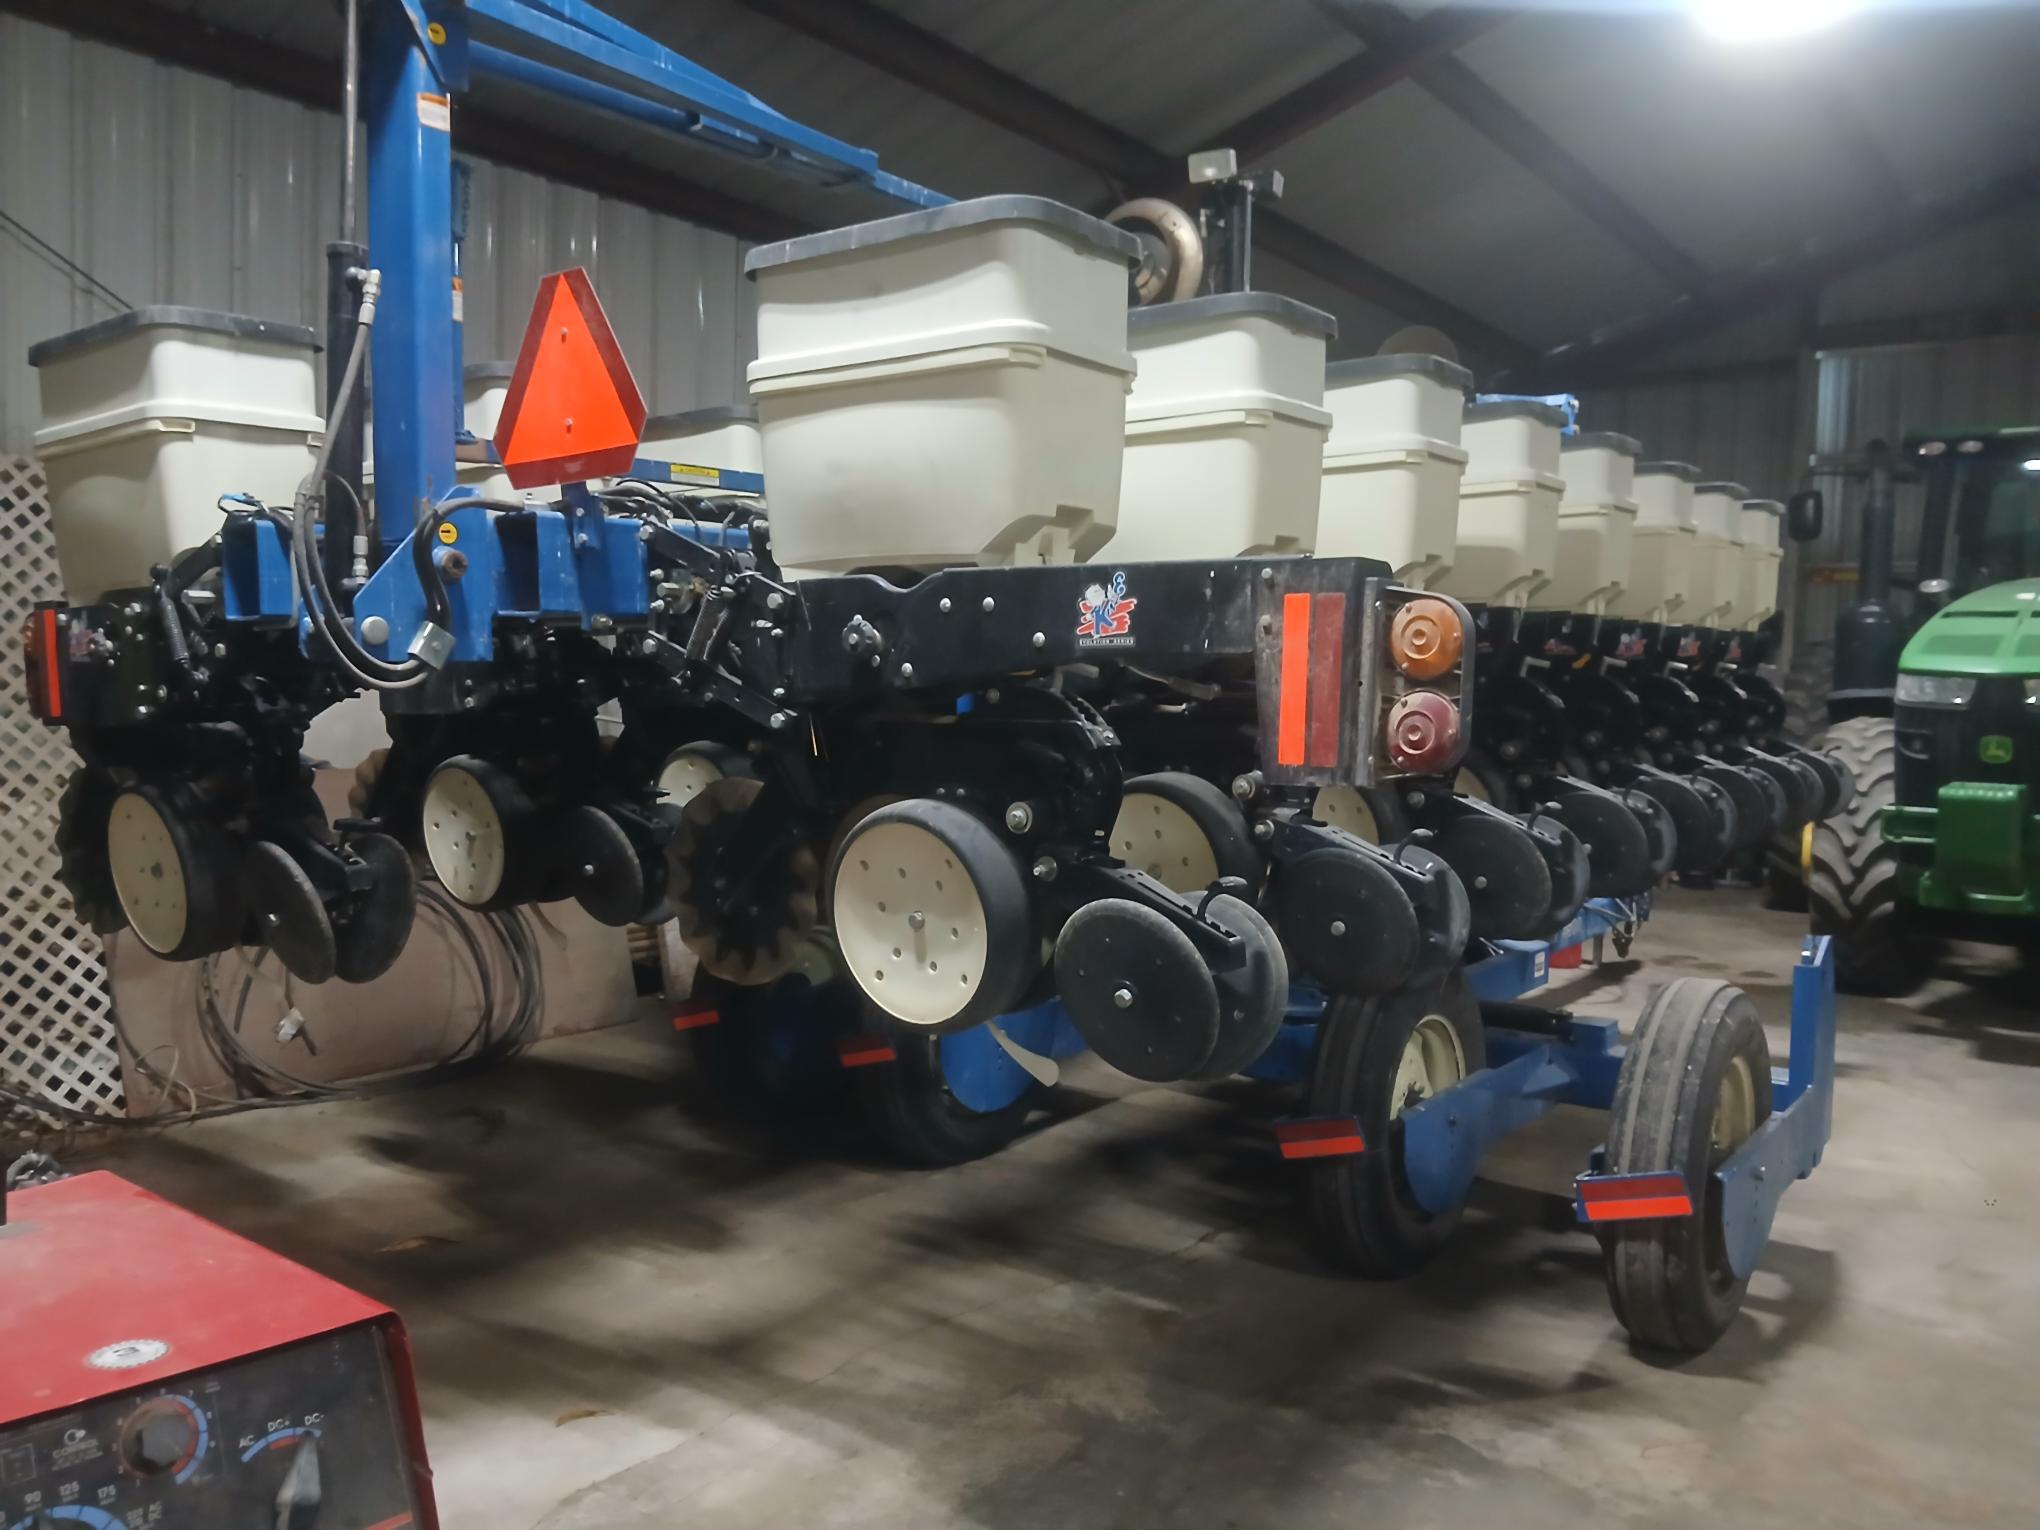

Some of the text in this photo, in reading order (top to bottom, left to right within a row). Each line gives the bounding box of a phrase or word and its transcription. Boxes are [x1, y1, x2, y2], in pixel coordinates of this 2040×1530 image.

[238, 1434, 254, 1449] AC
[59, 1481, 80, 1497] 125
[97, 1484, 117, 1499] 175
